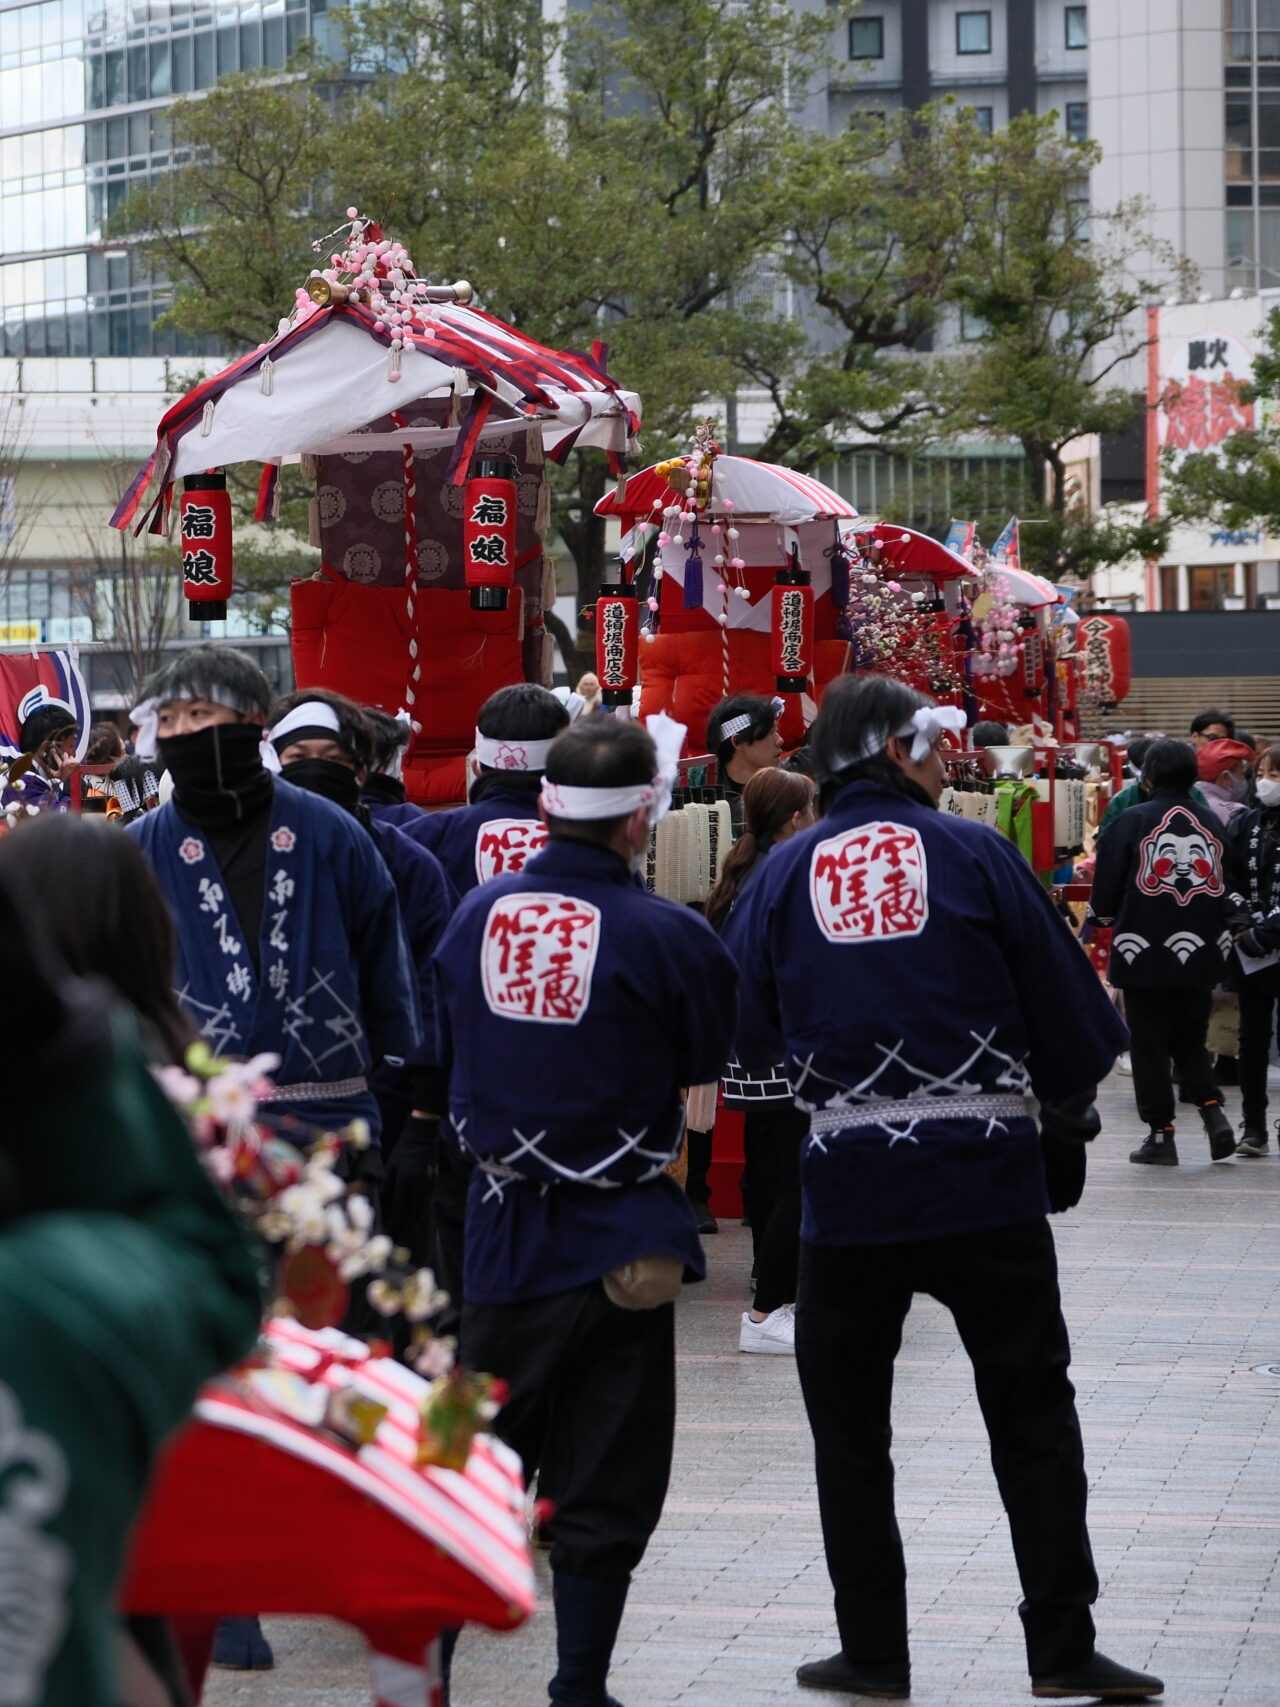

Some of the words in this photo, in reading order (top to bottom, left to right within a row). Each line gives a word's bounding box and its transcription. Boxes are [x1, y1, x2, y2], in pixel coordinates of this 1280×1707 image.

[183, 504, 220, 585] 福娘
[470, 495, 508, 565] 福娘
[603, 604, 626, 685] 道頓堀商店会
[784, 592, 804, 670] 道頓堀商店会
